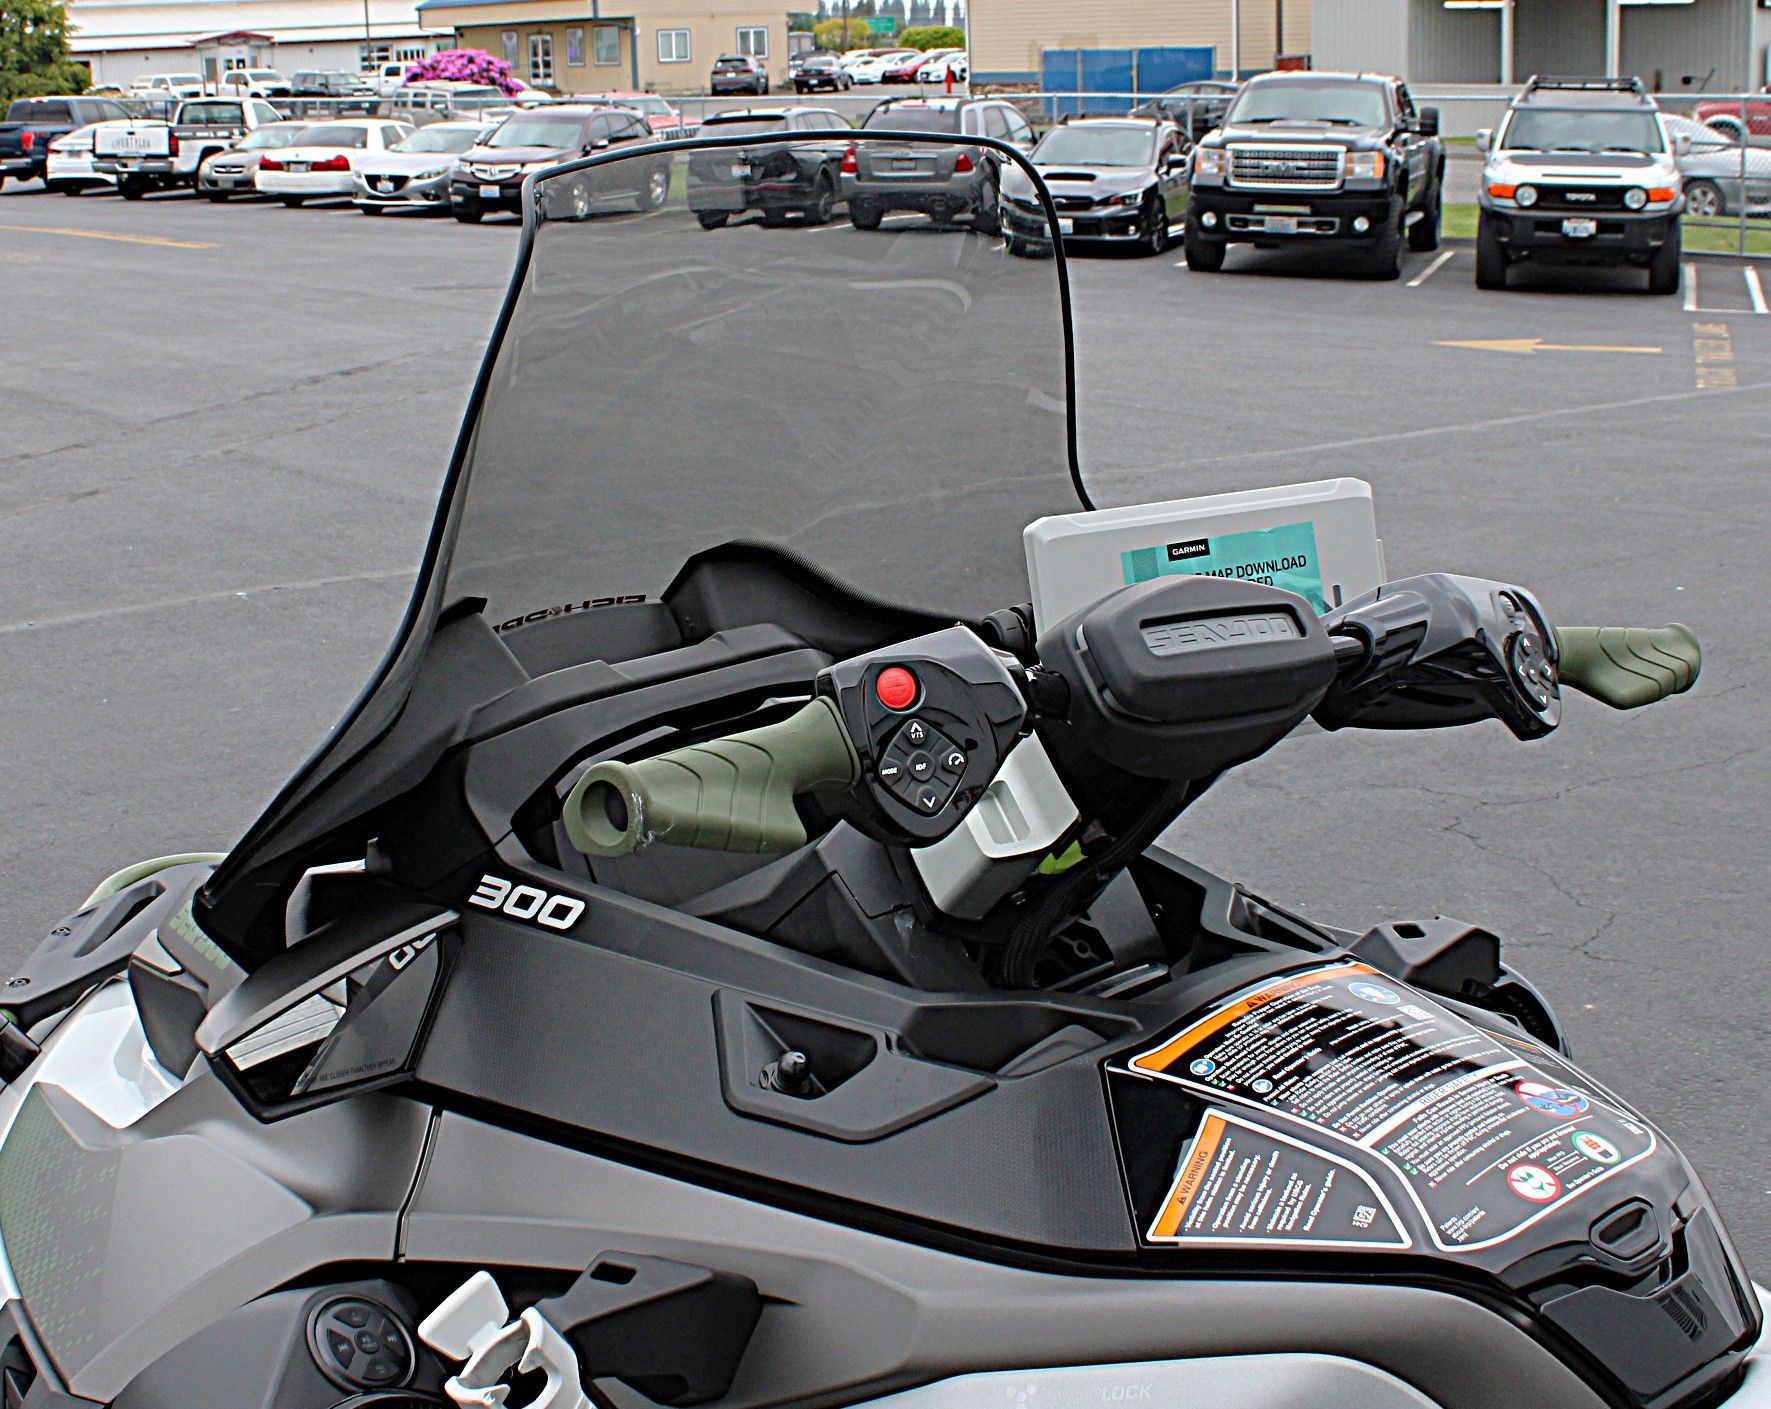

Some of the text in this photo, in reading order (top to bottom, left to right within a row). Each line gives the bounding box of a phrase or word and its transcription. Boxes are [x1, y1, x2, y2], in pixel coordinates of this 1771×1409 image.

[1565, 192, 1597, 201] TOYOTA
[1172, 544, 1206, 556] GARMIN
[1236, 555, 1307, 577] DOWNLOAD
[911, 730, 924, 740] VTS
[881, 767, 898, 776] MODE
[468, 873, 587, 931] 300
[1252, 981, 1302, 1003] WARNING
[1418, 1072, 1479, 1105] RIDER SAFETY
[1181, 1149, 1208, 1194] WARNING
[1101, 1383, 1153, 1402] LOCK
